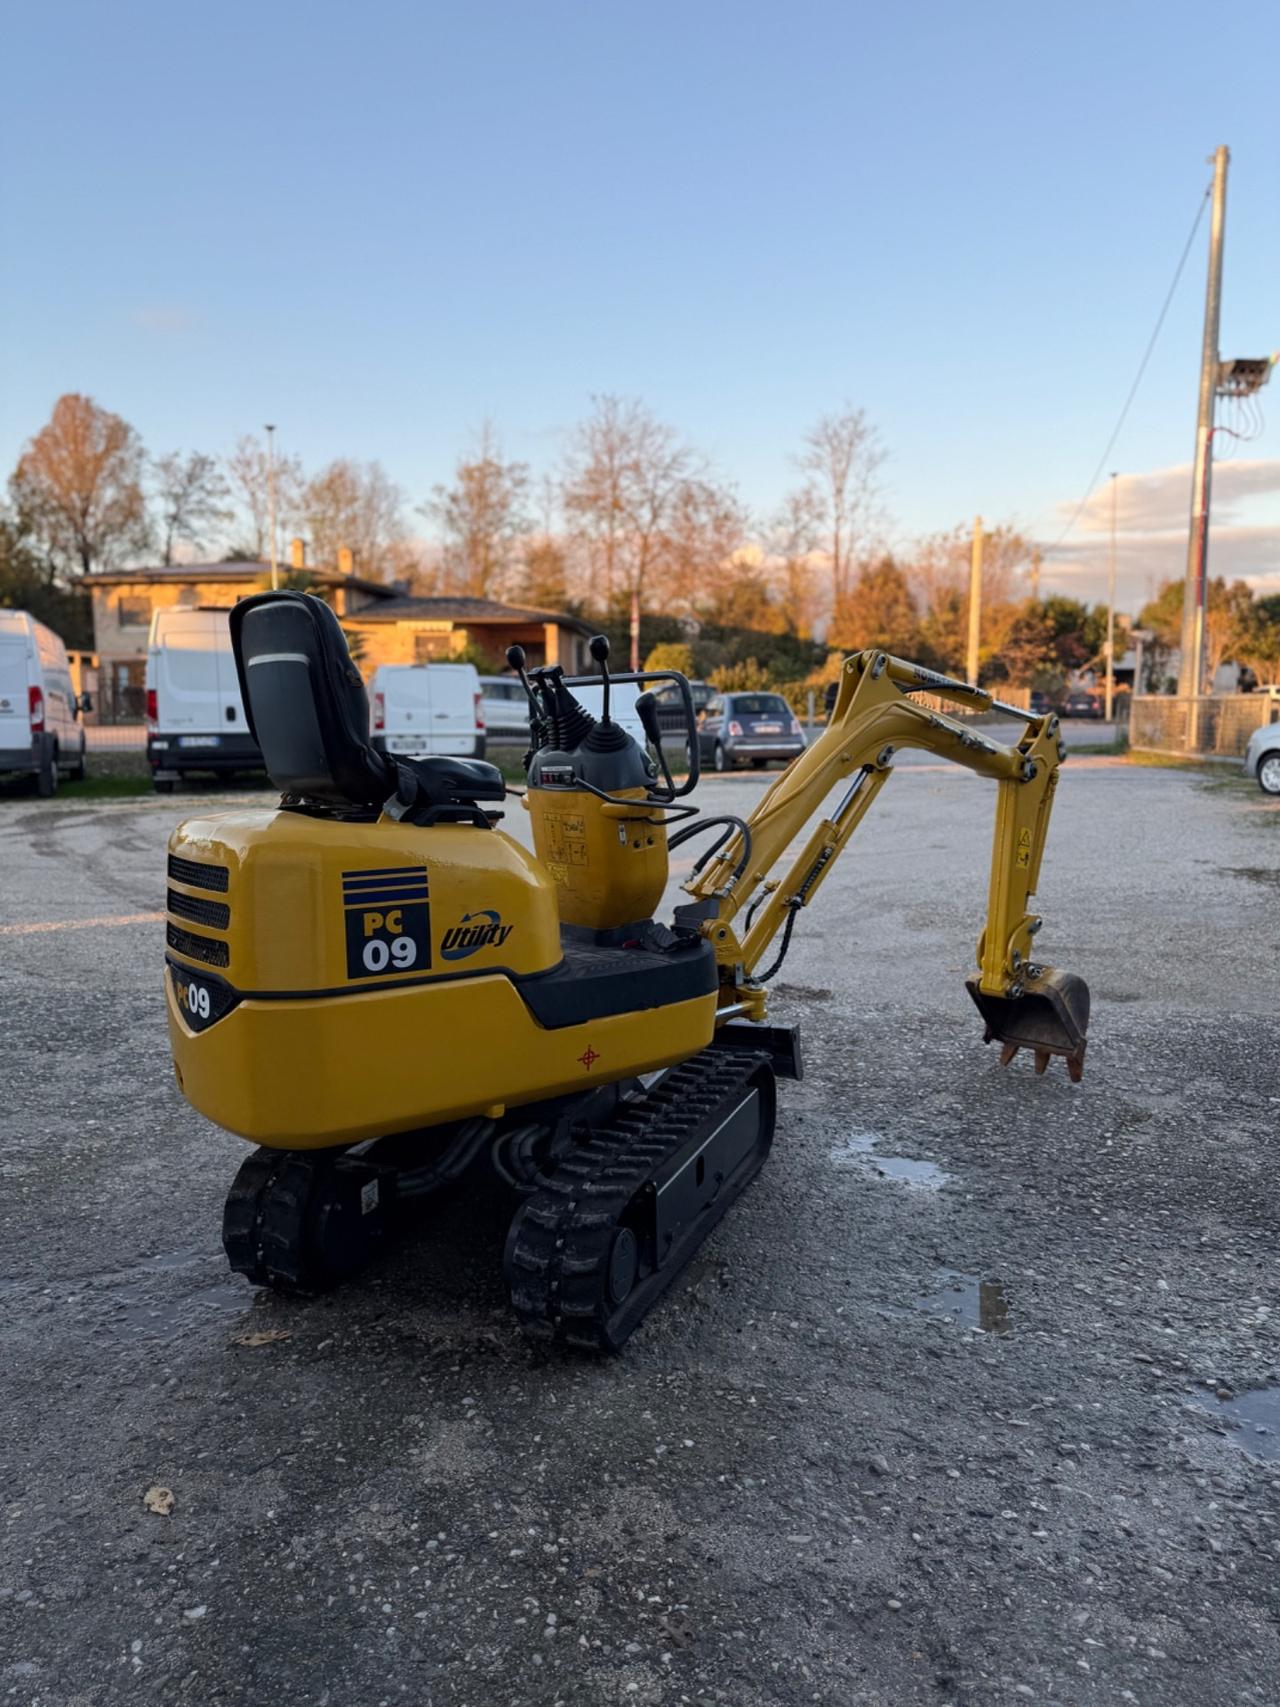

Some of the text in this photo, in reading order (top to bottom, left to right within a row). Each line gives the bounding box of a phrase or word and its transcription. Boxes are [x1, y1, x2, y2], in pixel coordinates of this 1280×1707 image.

[363, 910, 402, 937] PC
[440, 923, 514, 949] Utility
[362, 936, 417, 972] 09
